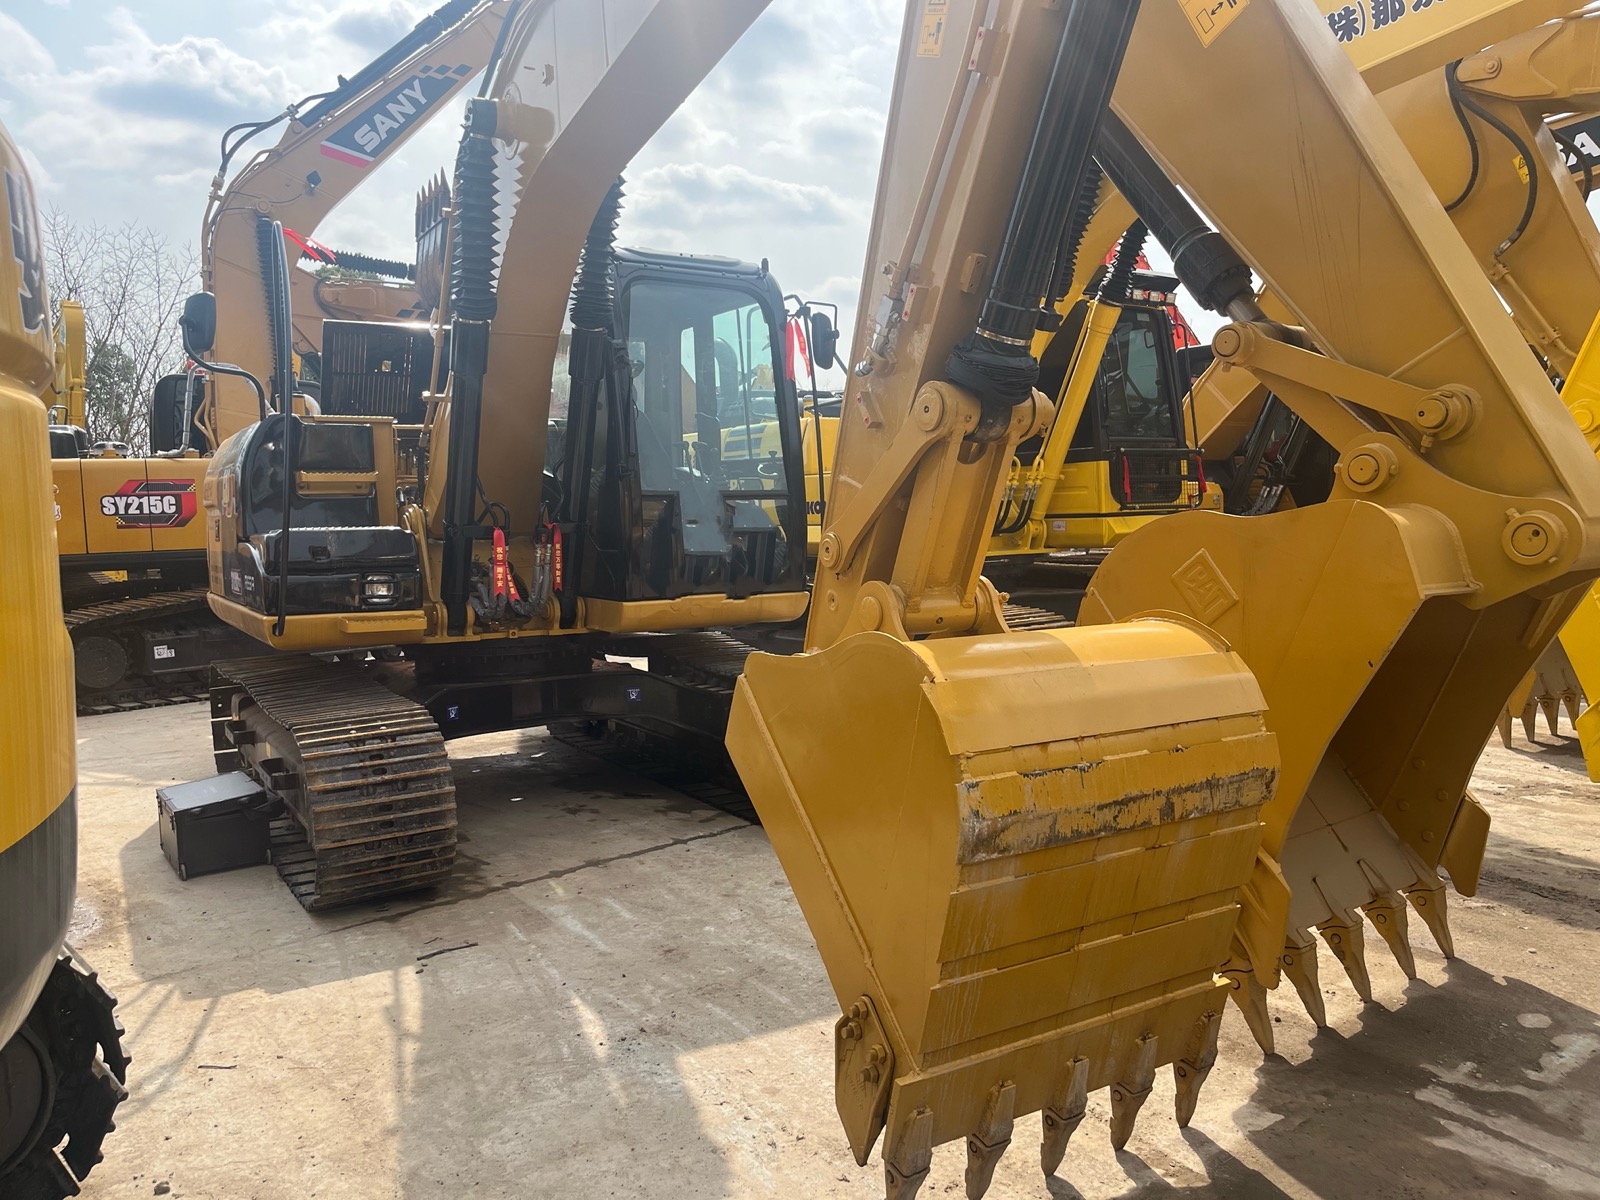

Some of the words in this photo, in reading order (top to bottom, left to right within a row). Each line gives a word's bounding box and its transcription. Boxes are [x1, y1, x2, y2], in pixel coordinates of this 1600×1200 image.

[354, 78, 428, 153] SANY
[101, 495, 177, 515] SY215C
[1180, 561, 1230, 616] CAT
